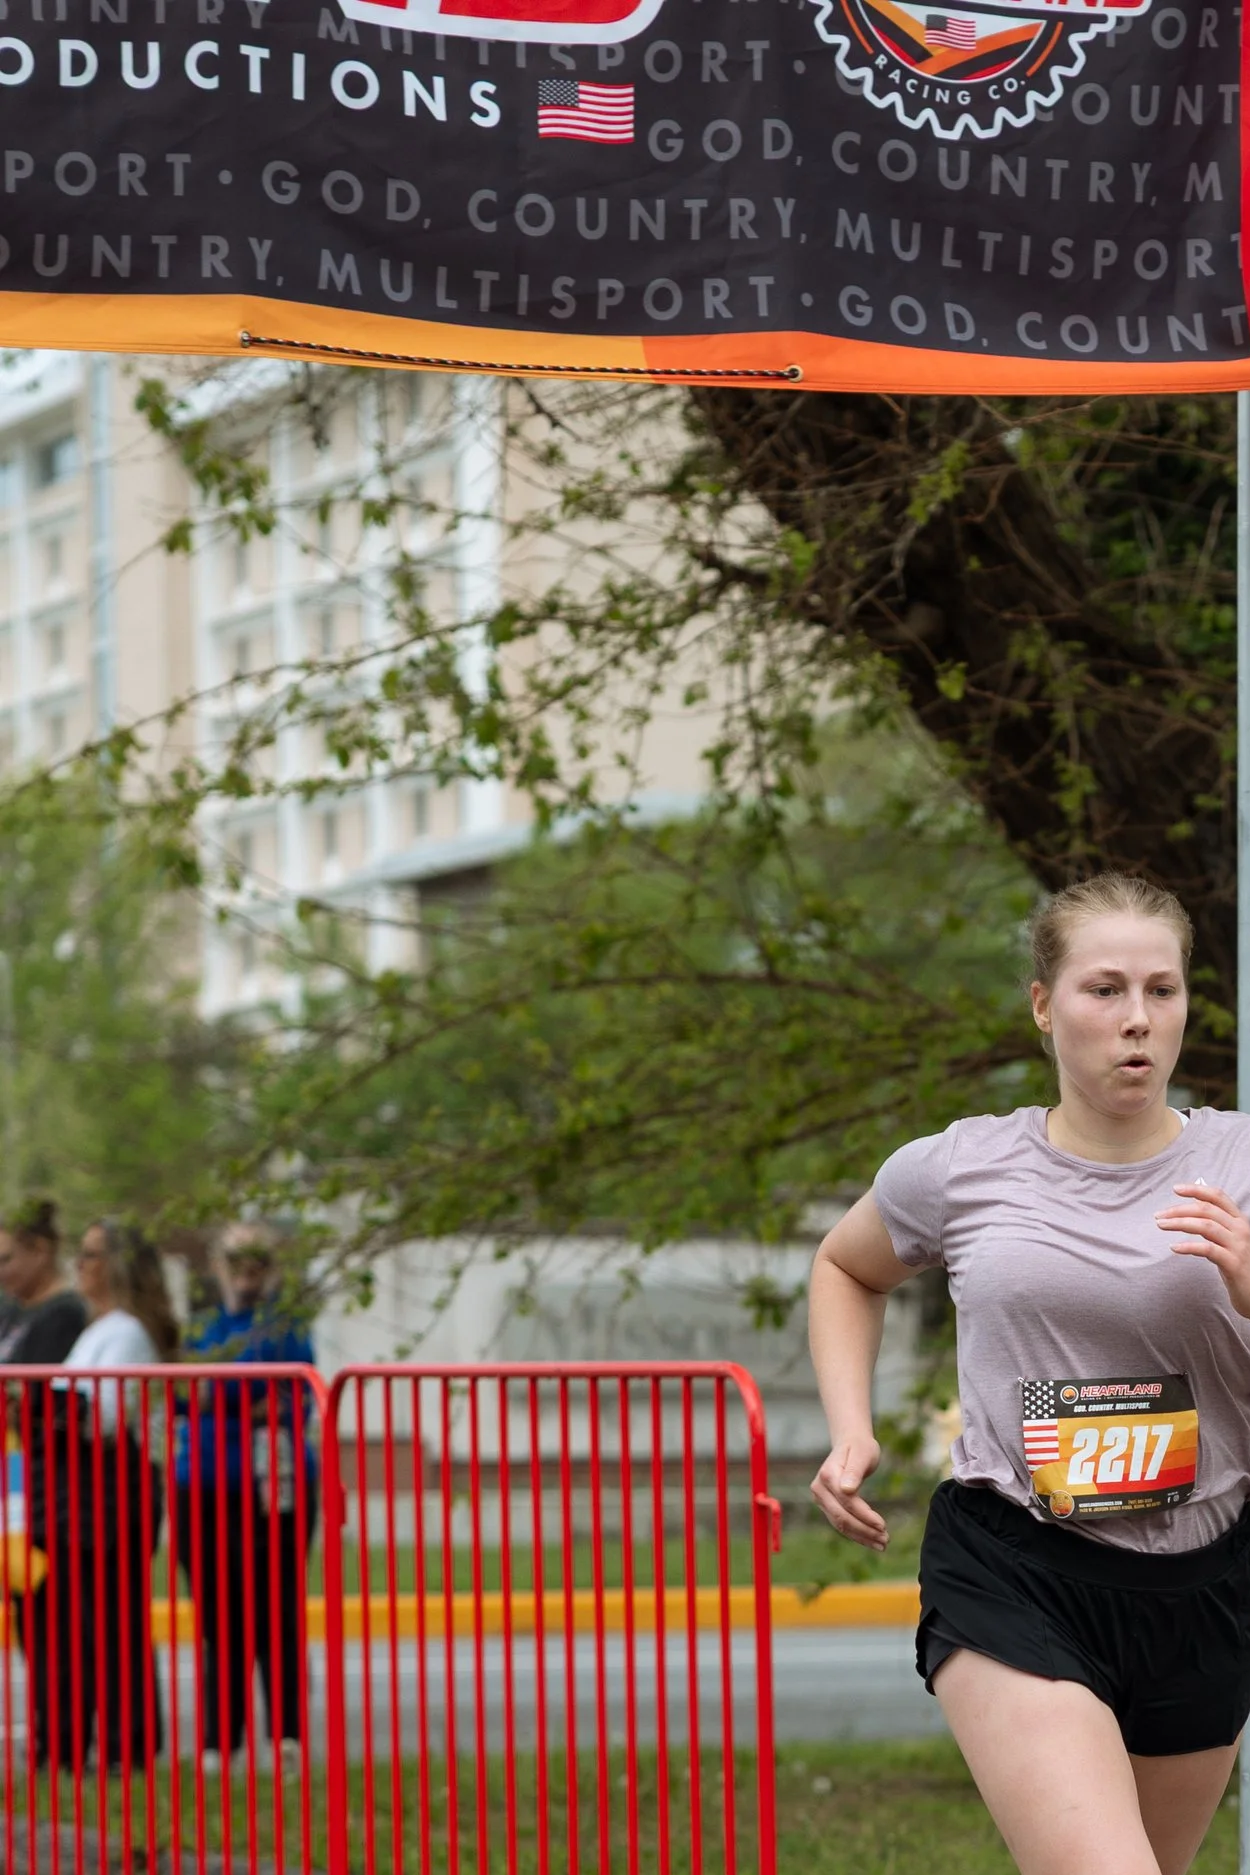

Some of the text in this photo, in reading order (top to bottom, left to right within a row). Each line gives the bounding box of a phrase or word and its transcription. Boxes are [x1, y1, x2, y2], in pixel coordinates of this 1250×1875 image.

[1106, 7, 1241, 49] POR
[0, 37, 501, 128] ODUCTIONS
[874, 54, 971, 105] RACING
[988, 77, 1026, 99] CO.
[1032, 82, 1240, 125] OUNT
[648, 119, 803, 166] GOD,
[832, 130, 1157, 207] COUNTRY,
[261, 160, 431, 229] GOD,
[468, 188, 807, 244] COUNTRY,
[0, 233, 284, 287] UNTRY,
[318, 249, 775, 320] MULTISPORT
[1017, 304, 1247, 355] COUNT
[1080, 1383, 1162, 1397] HEARTLAND
[1066, 1424, 1174, 1485] 2217
